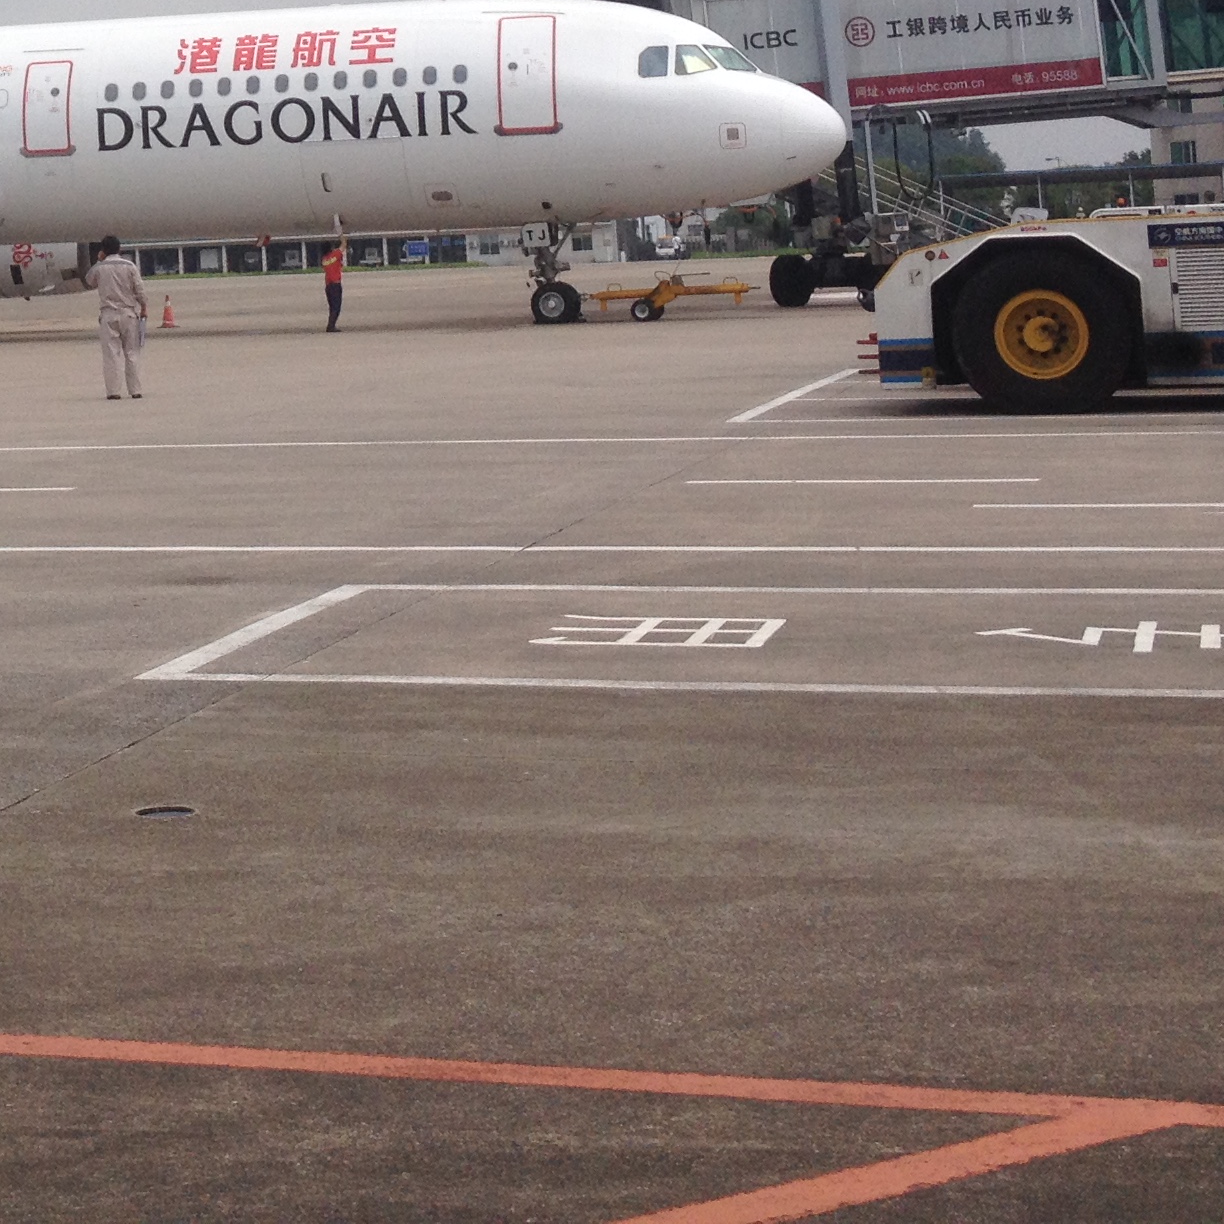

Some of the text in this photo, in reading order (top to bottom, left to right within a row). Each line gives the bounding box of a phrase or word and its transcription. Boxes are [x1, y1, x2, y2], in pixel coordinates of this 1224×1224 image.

[743, 28, 798, 50] ICBC
[886, 5, 1075, 39] 工银跨境人民币业务
[174, 27, 397, 74] 港龍航空
[96, 90, 478, 151] DRAGONAIR
